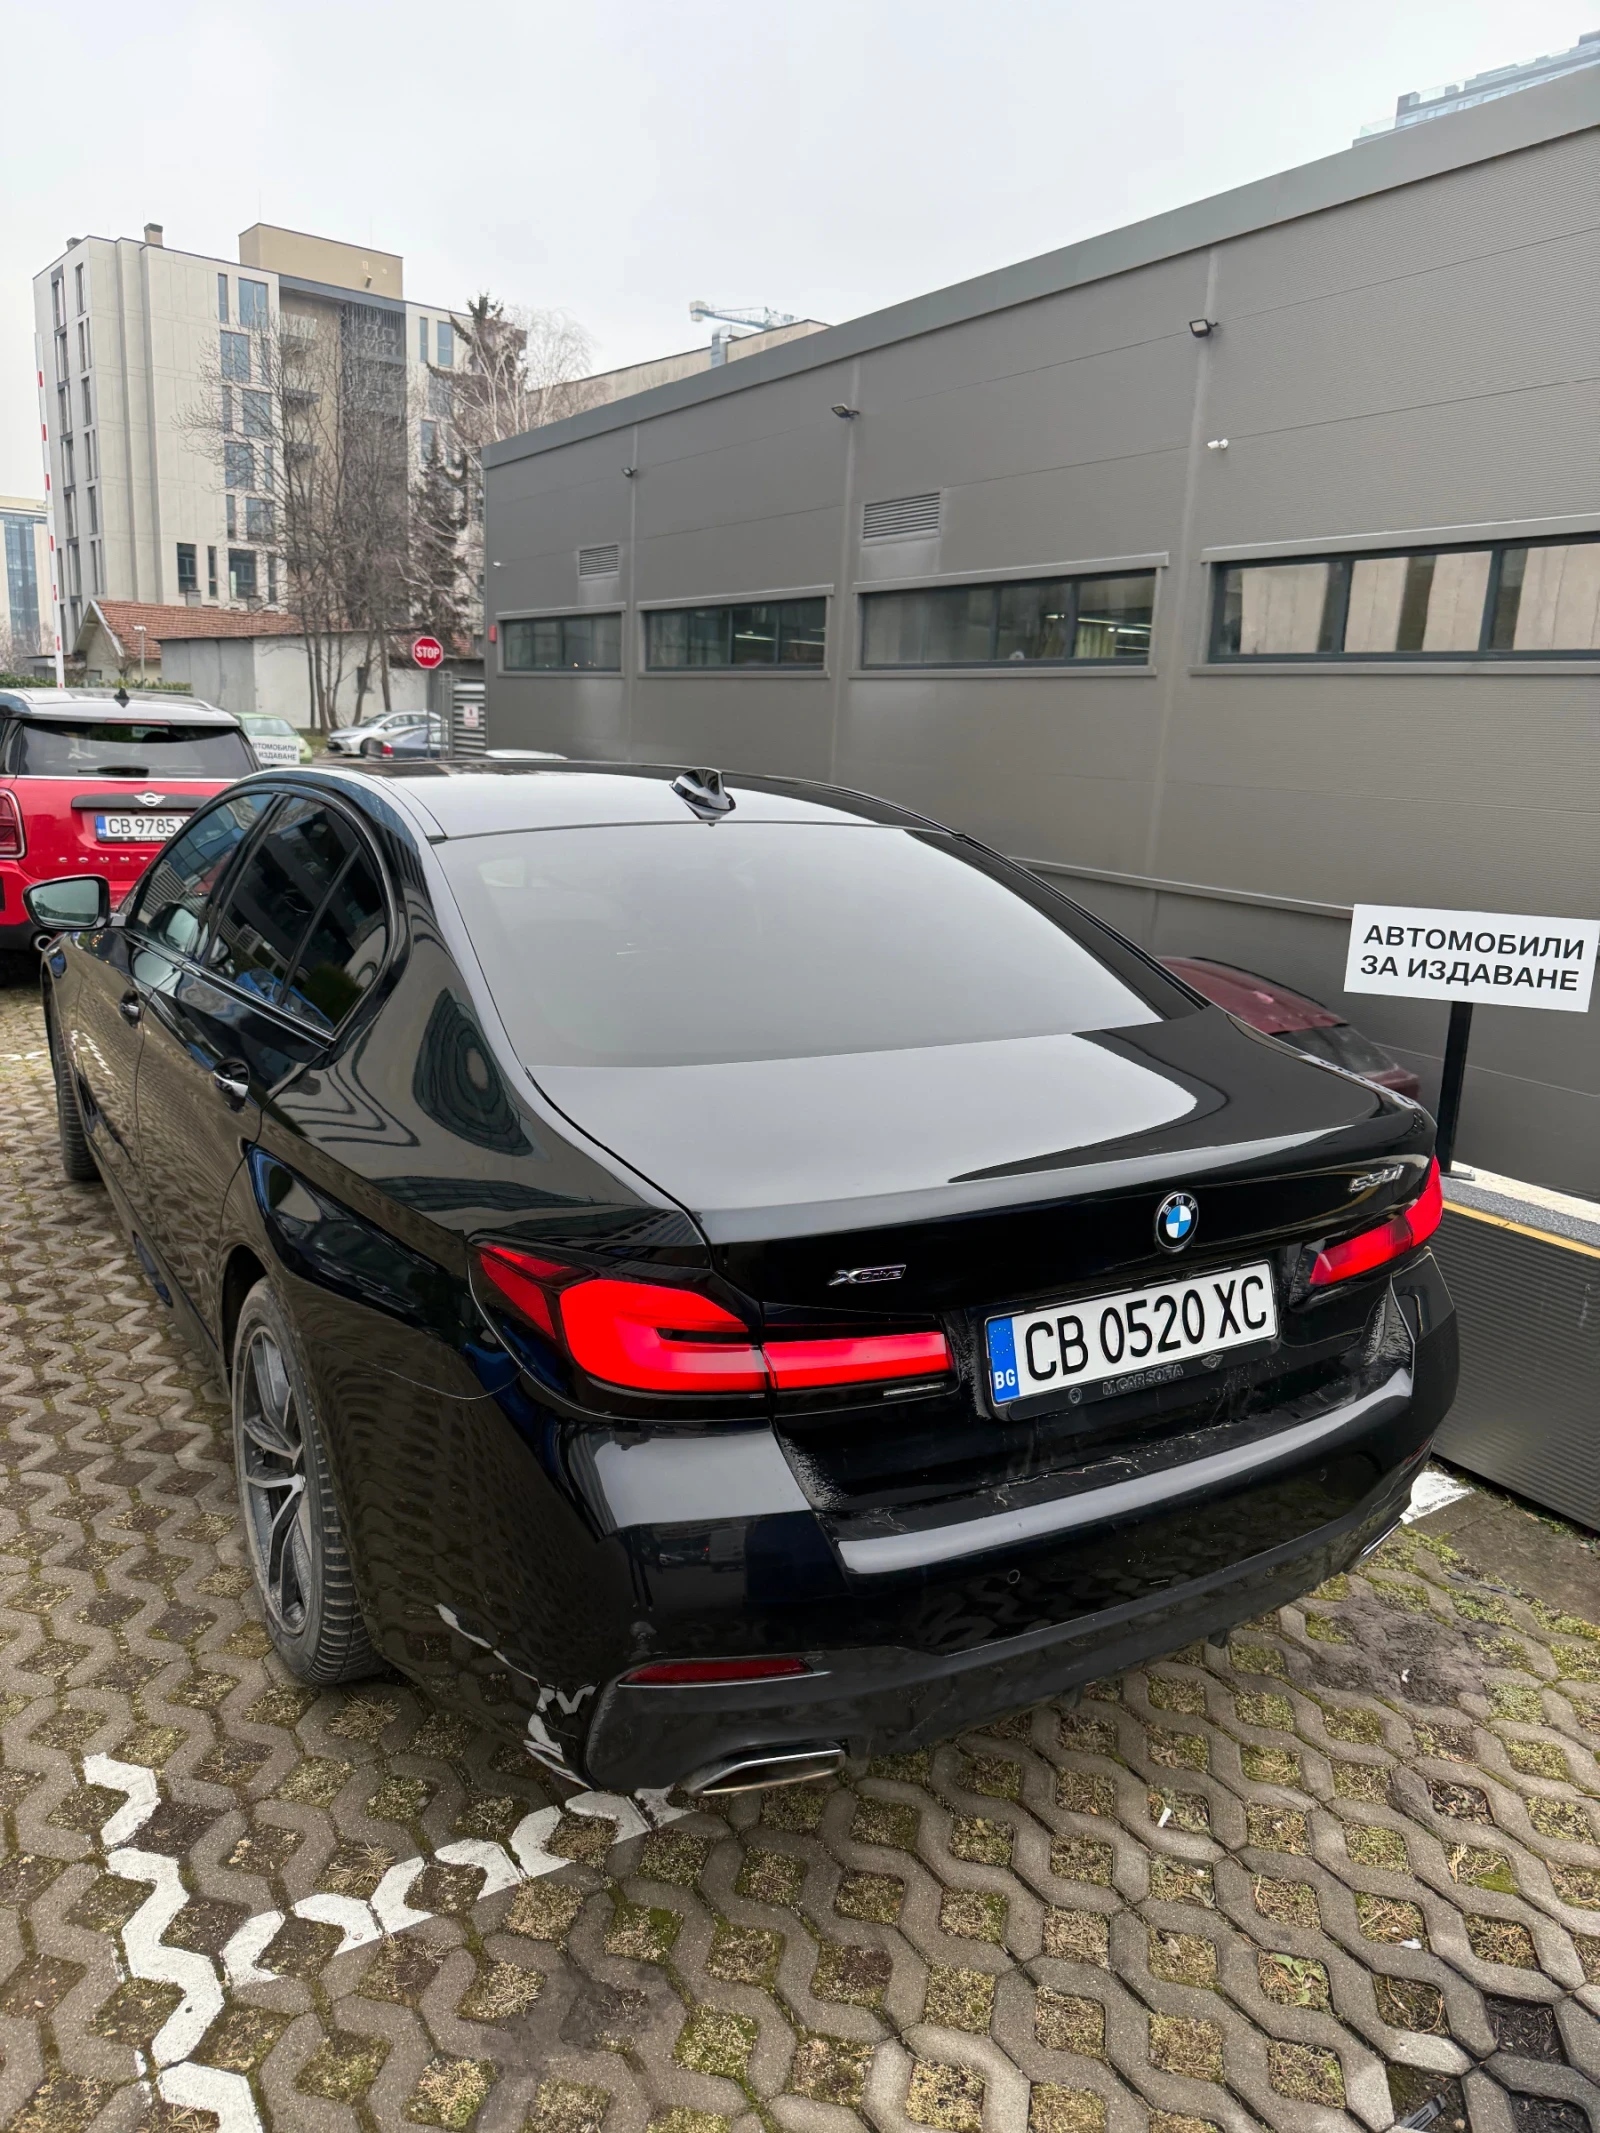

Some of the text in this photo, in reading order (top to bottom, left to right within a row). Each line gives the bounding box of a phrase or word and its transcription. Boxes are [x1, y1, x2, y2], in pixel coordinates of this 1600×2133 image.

[415, 645, 440, 659] STOP
[252, 742, 298, 752] ВТОМОБИЛИ
[258, 751, 298, 761] ИЗДАВАНЕ
[109, 818, 132, 834] CB
[134, 818, 177, 834] 9785
[1363, 924, 1585, 960] АВТОМОБИЛИ
[1360, 954, 1579, 992] ЗА ИЗДАВАНЕ
[1162, 1195, 1198, 1216] BMW
[1025, 1275, 1267, 1381] CB 0520 XC
[994, 1368, 1016, 1390] BG
